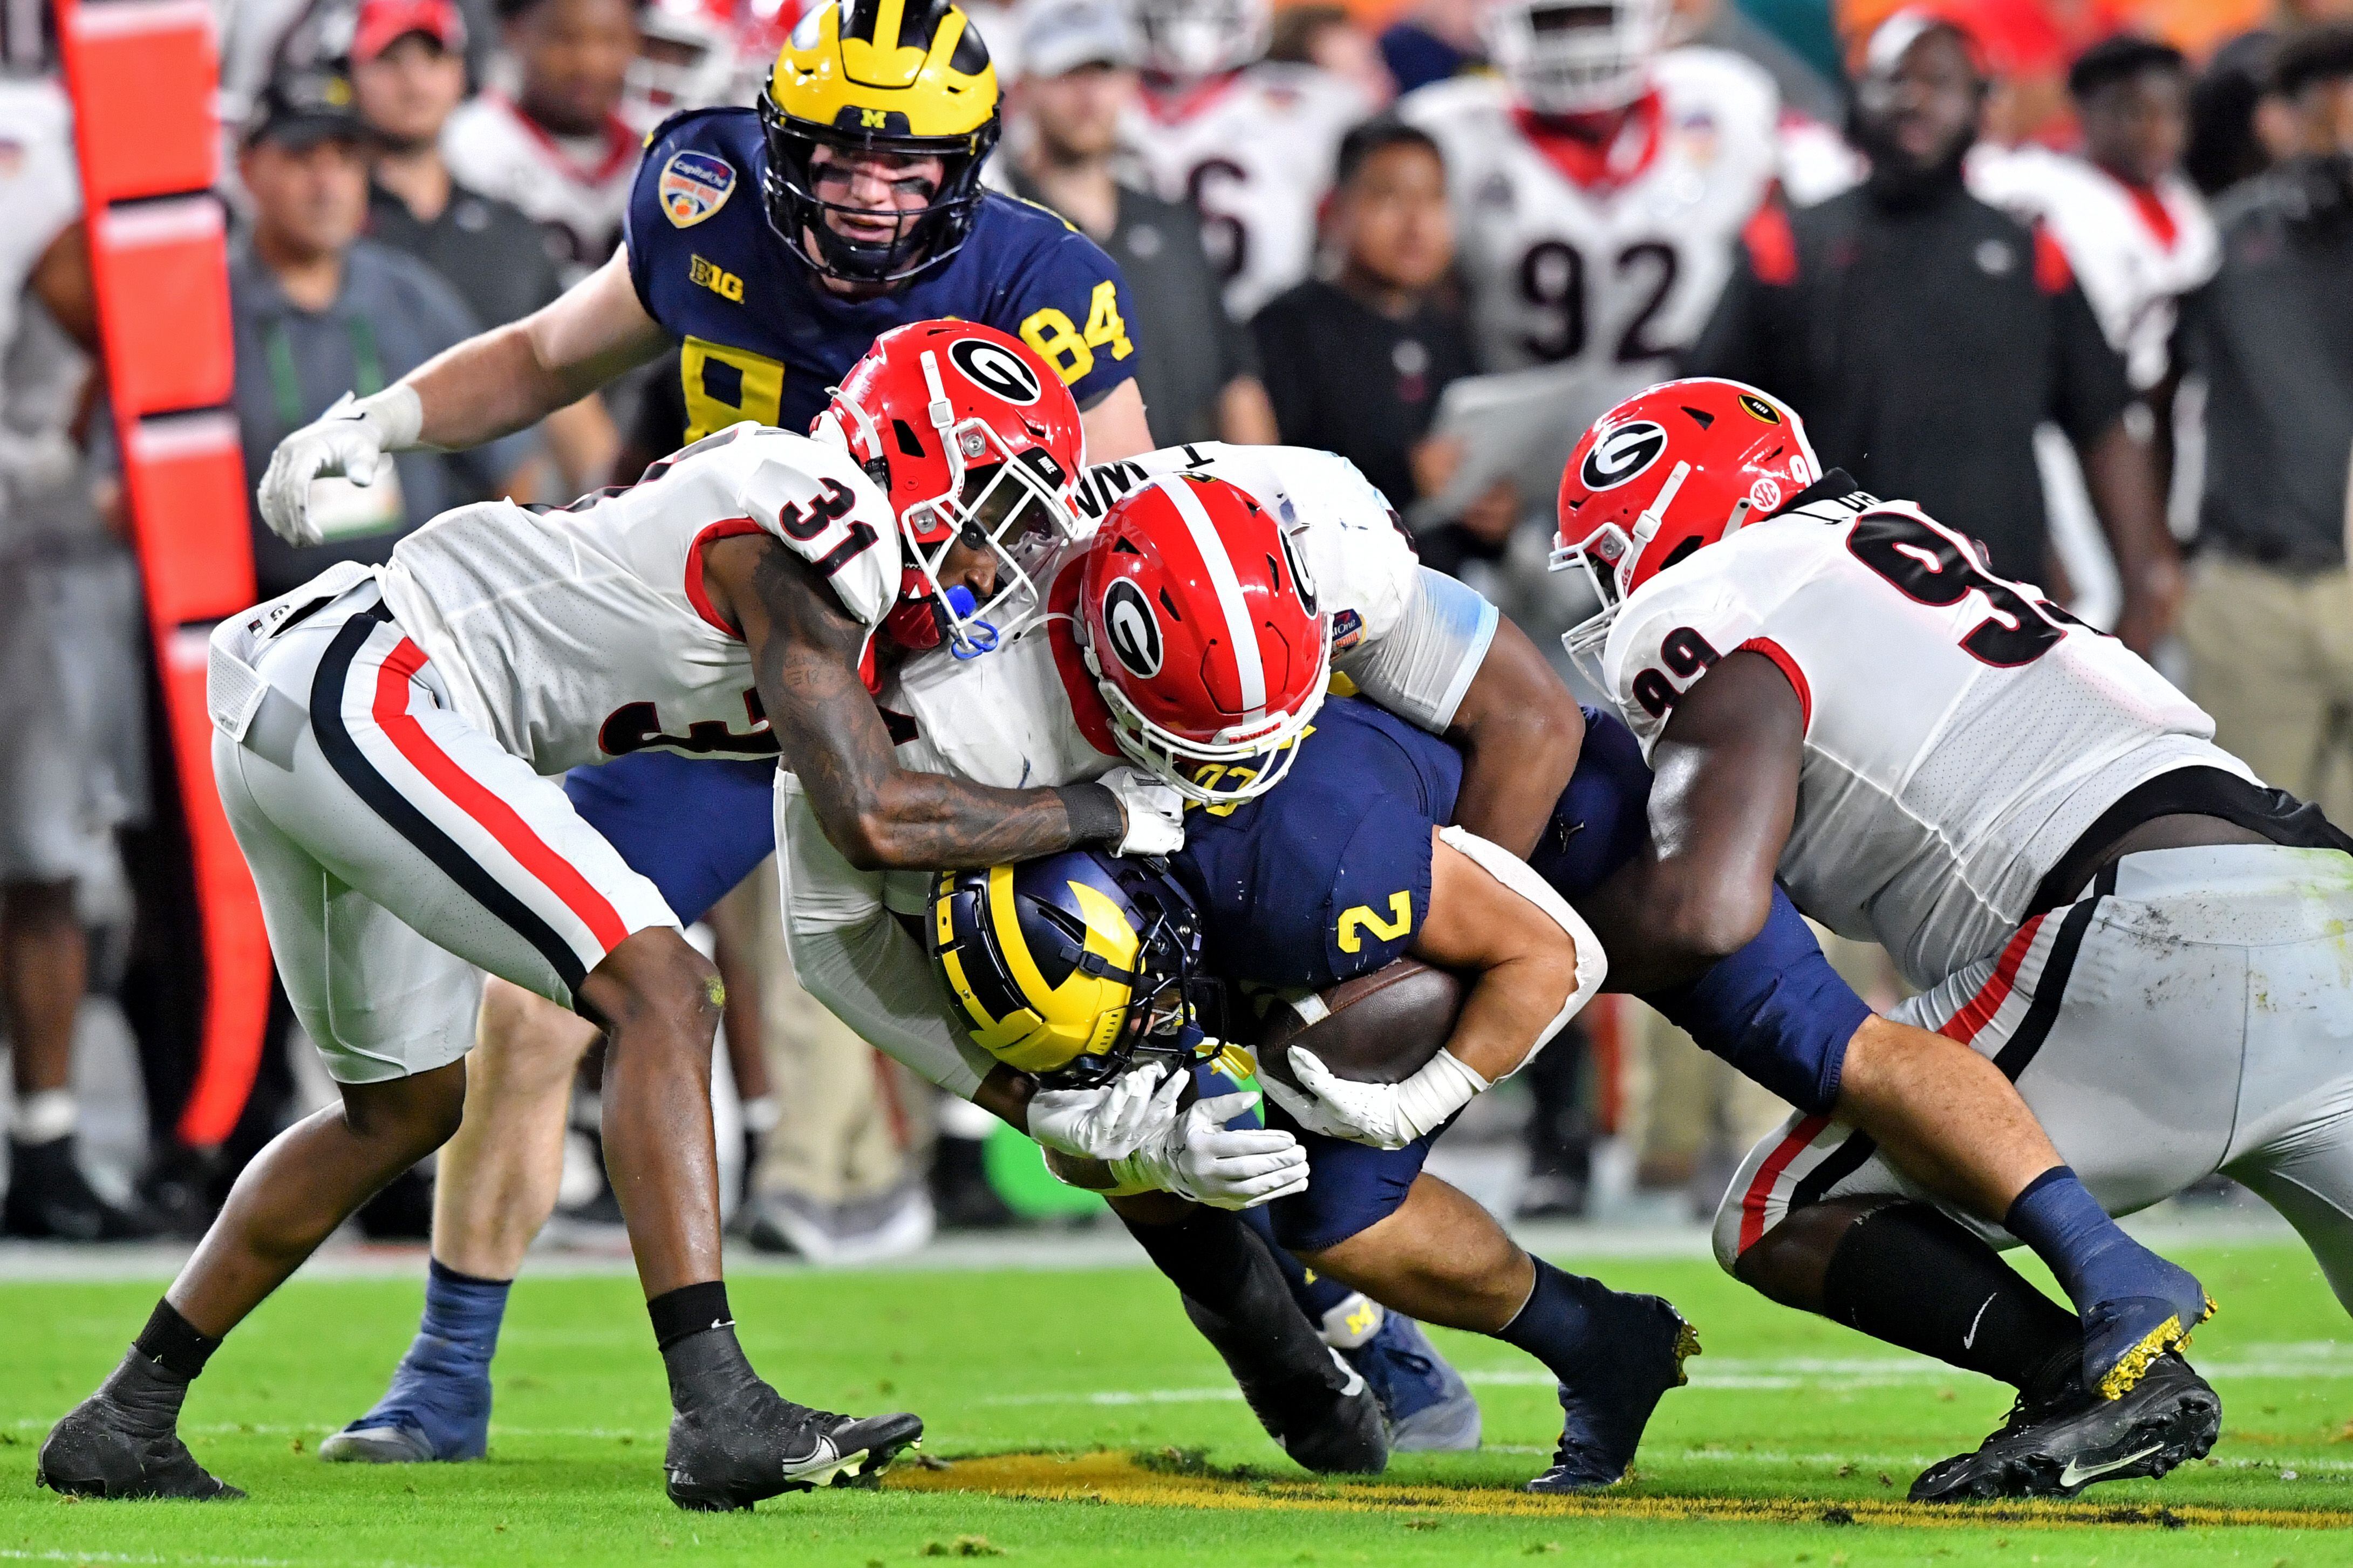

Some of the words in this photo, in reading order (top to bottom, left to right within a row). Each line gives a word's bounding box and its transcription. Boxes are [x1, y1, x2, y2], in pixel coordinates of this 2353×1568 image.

[860, 109, 887, 129] M
[1019, 280, 1134, 386] 84
[1518, 239, 1680, 364] 92
[948, 338, 1041, 405] G
[1037, 456, 1058, 475] NIKE
[1581, 421, 1666, 490] G
[779, 477, 879, 578] 31
[1754, 482, 1777, 507] SEC
[1104, 578, 1162, 677] G
[1632, 626, 1723, 718] 99
[1338, 890, 1411, 953] 2
[1096, 1014, 1118, 1051] JORDAN
[1346, 1302, 1376, 1335] M
